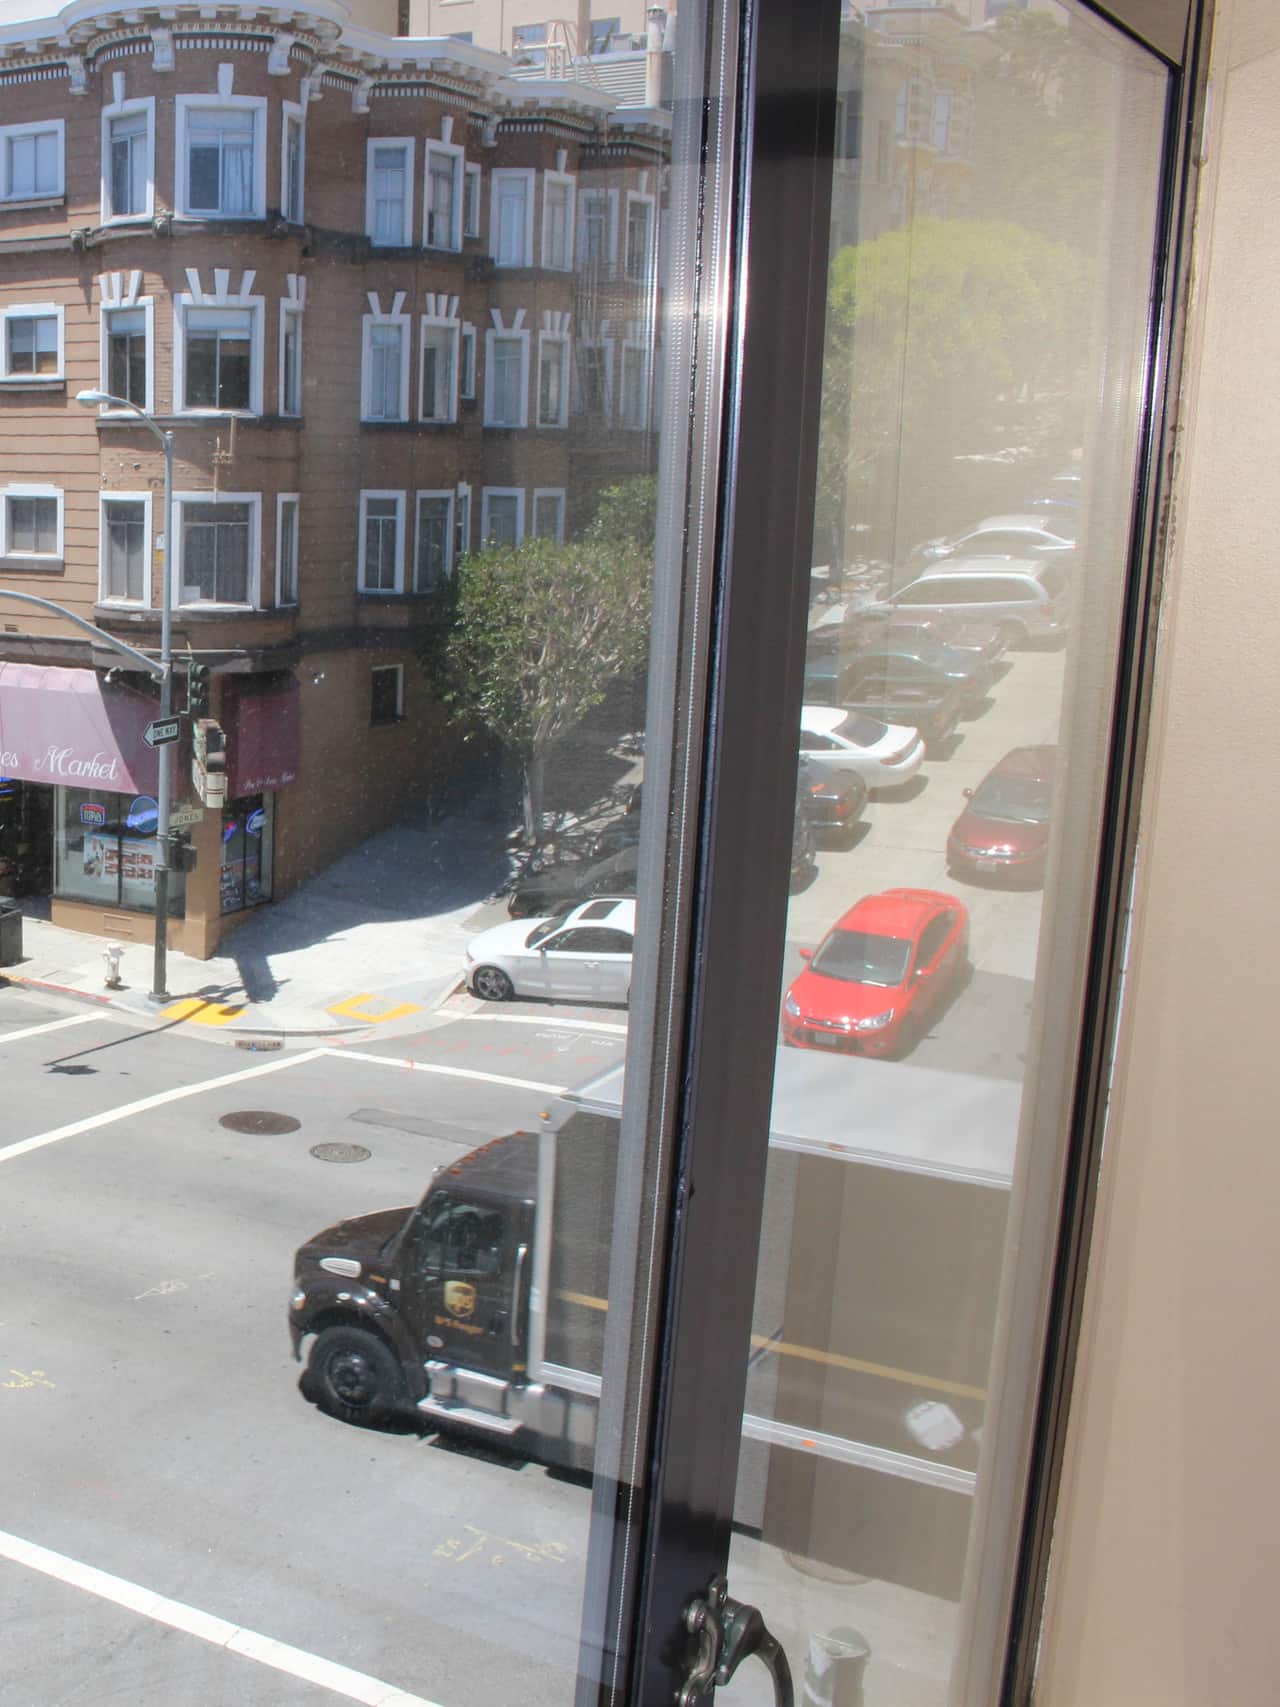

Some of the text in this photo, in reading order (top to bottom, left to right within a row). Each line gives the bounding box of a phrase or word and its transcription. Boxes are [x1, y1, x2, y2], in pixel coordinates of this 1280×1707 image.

[153, 726, 177, 738] ONE WAY
[34, 745, 118, 780] Market
[175, 812, 200, 824] JONES
